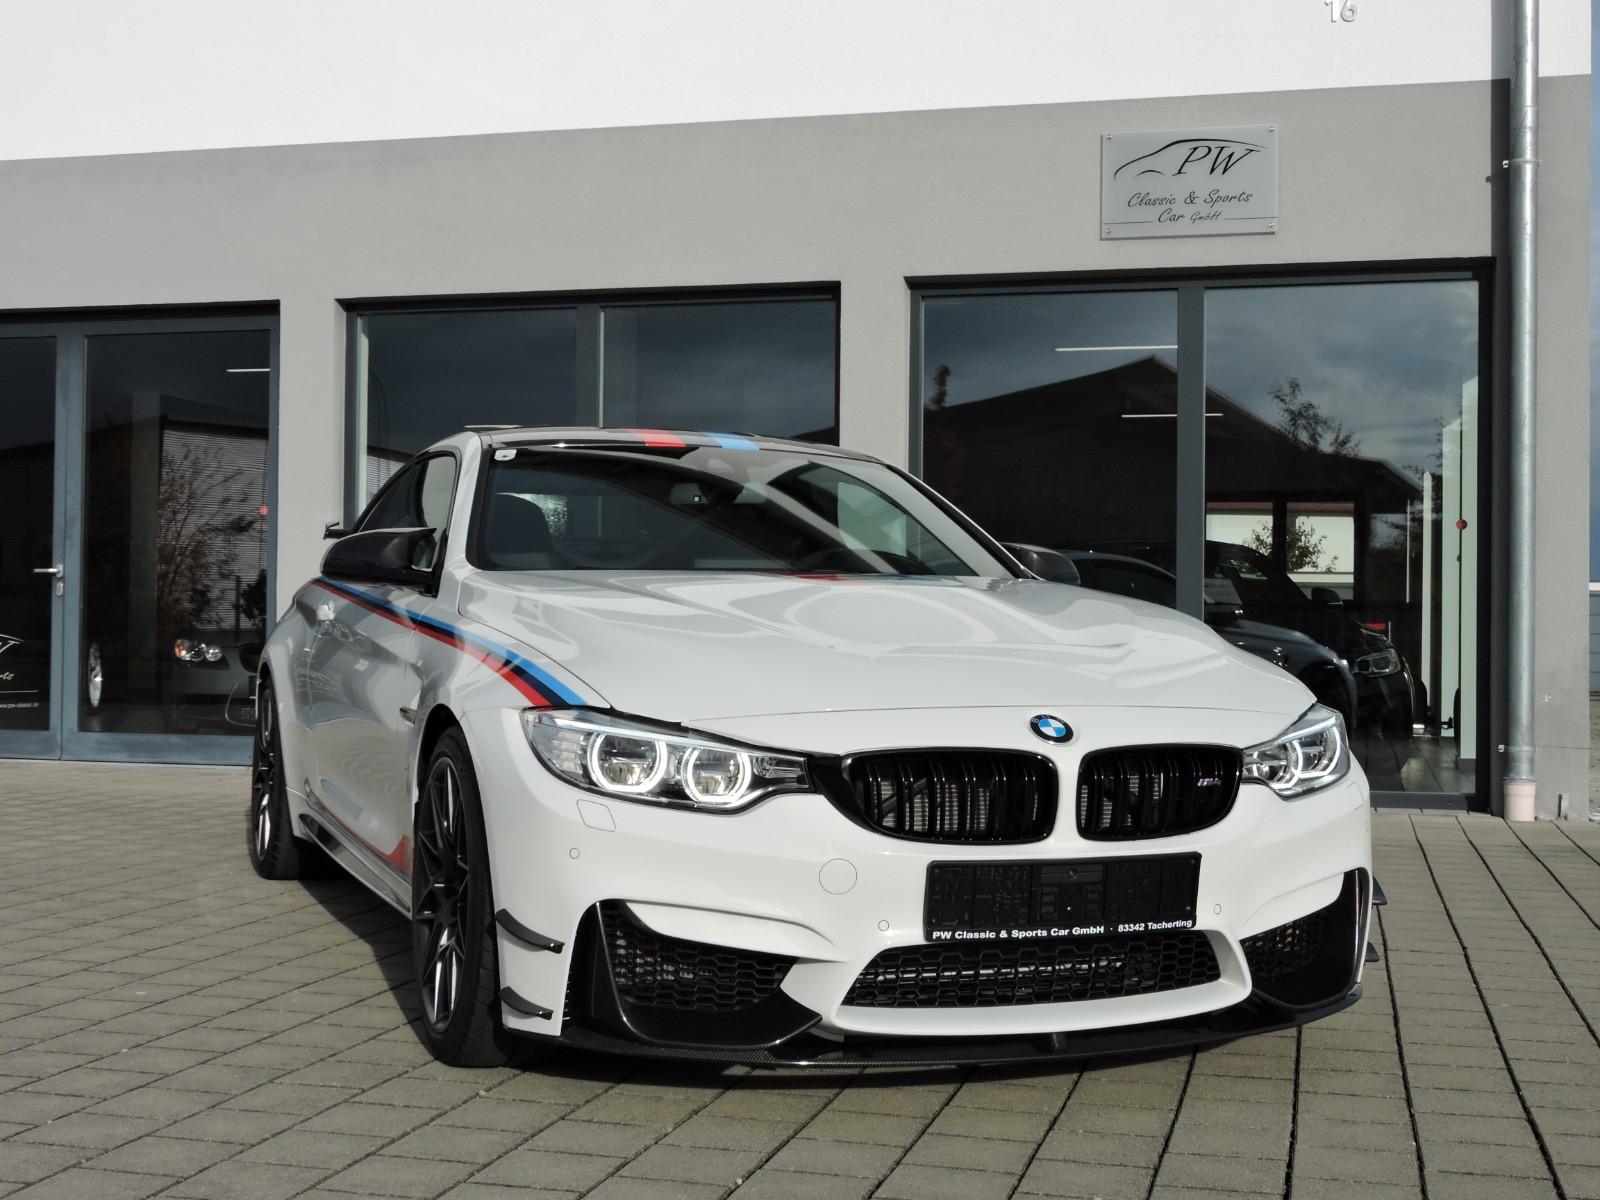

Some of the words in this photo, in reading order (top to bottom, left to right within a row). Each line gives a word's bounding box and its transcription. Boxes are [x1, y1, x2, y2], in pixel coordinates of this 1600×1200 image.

[1323, 0, 1360, 23] 16
[1171, 145, 1261, 177] PW
[1127, 192, 1176, 208] Classic
[1184, 191, 1199, 205] &
[1204, 189, 1253, 209] Sports
[1158, 208, 1185, 223] Car
[1190, 211, 1222, 224] GmbH
[932, 931, 952, 940] PW
[954, 930, 996, 939] Classic
[999, 929, 1008, 938] &
[1011, 928, 1048, 939] Sports
[1050, 928, 1069, 936] Car
[1072, 925, 1105, 935] GmbH
[1118, 923, 1145, 933] 83342
[1147, 919, 1193, 930] Tacherting
